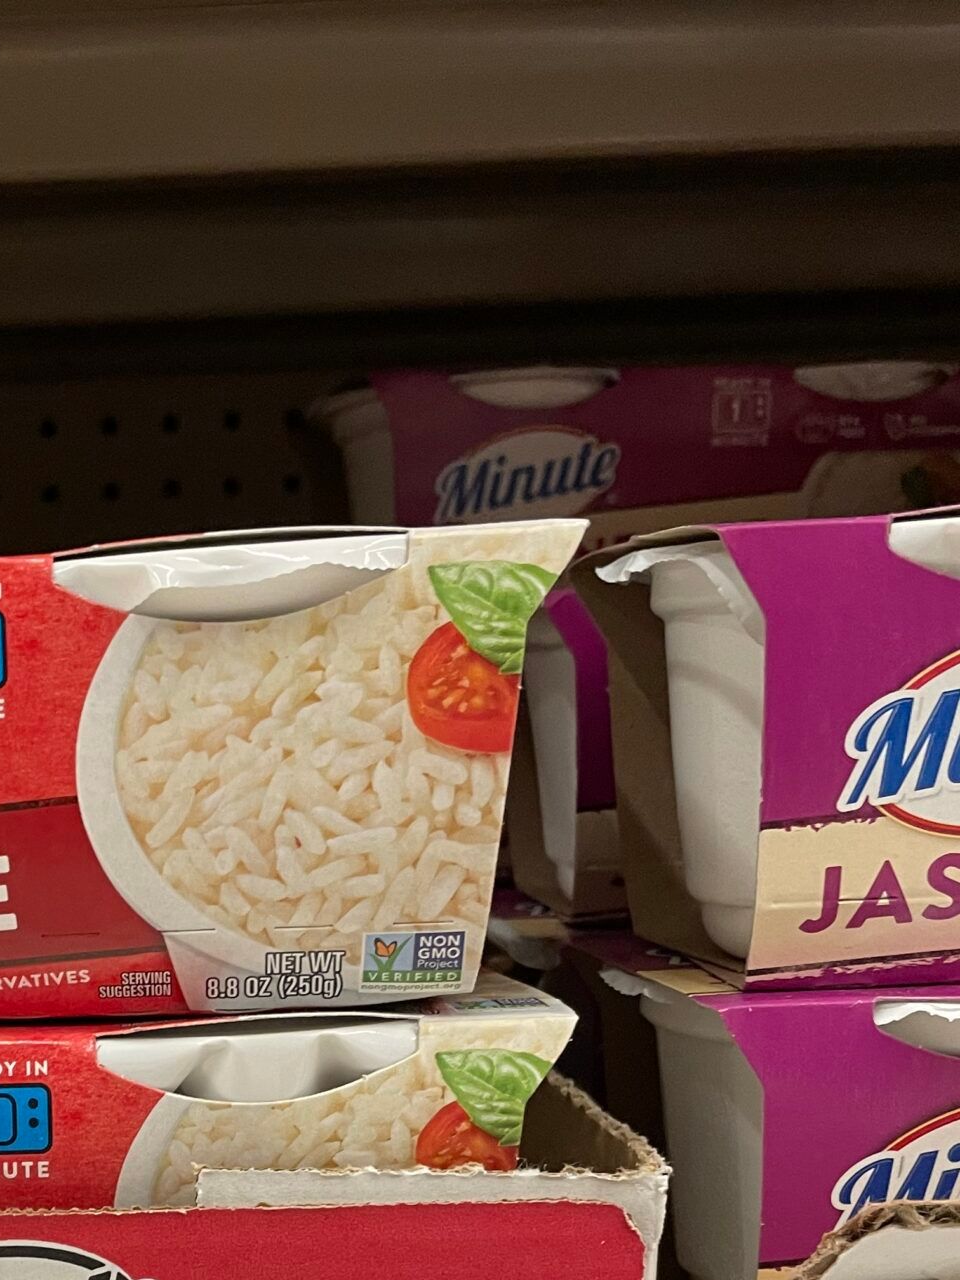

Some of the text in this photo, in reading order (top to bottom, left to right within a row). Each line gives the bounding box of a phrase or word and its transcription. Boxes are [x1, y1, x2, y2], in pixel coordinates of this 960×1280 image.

[441, 443, 617, 519] Minute
[420, 934, 461, 948] NON
[417, 947, 461, 960] GMO
[265, 950, 345, 975] NET WT
[417, 959, 459, 971] Project
[121, 971, 171, 985] SERVING
[368, 971, 458, 982] VERIFIED
[98, 984, 171, 999] SUGGESTION
[206, 974, 343, 999] 8.8 OZ (250g)
[26, 1059, 49, 1077] IN
